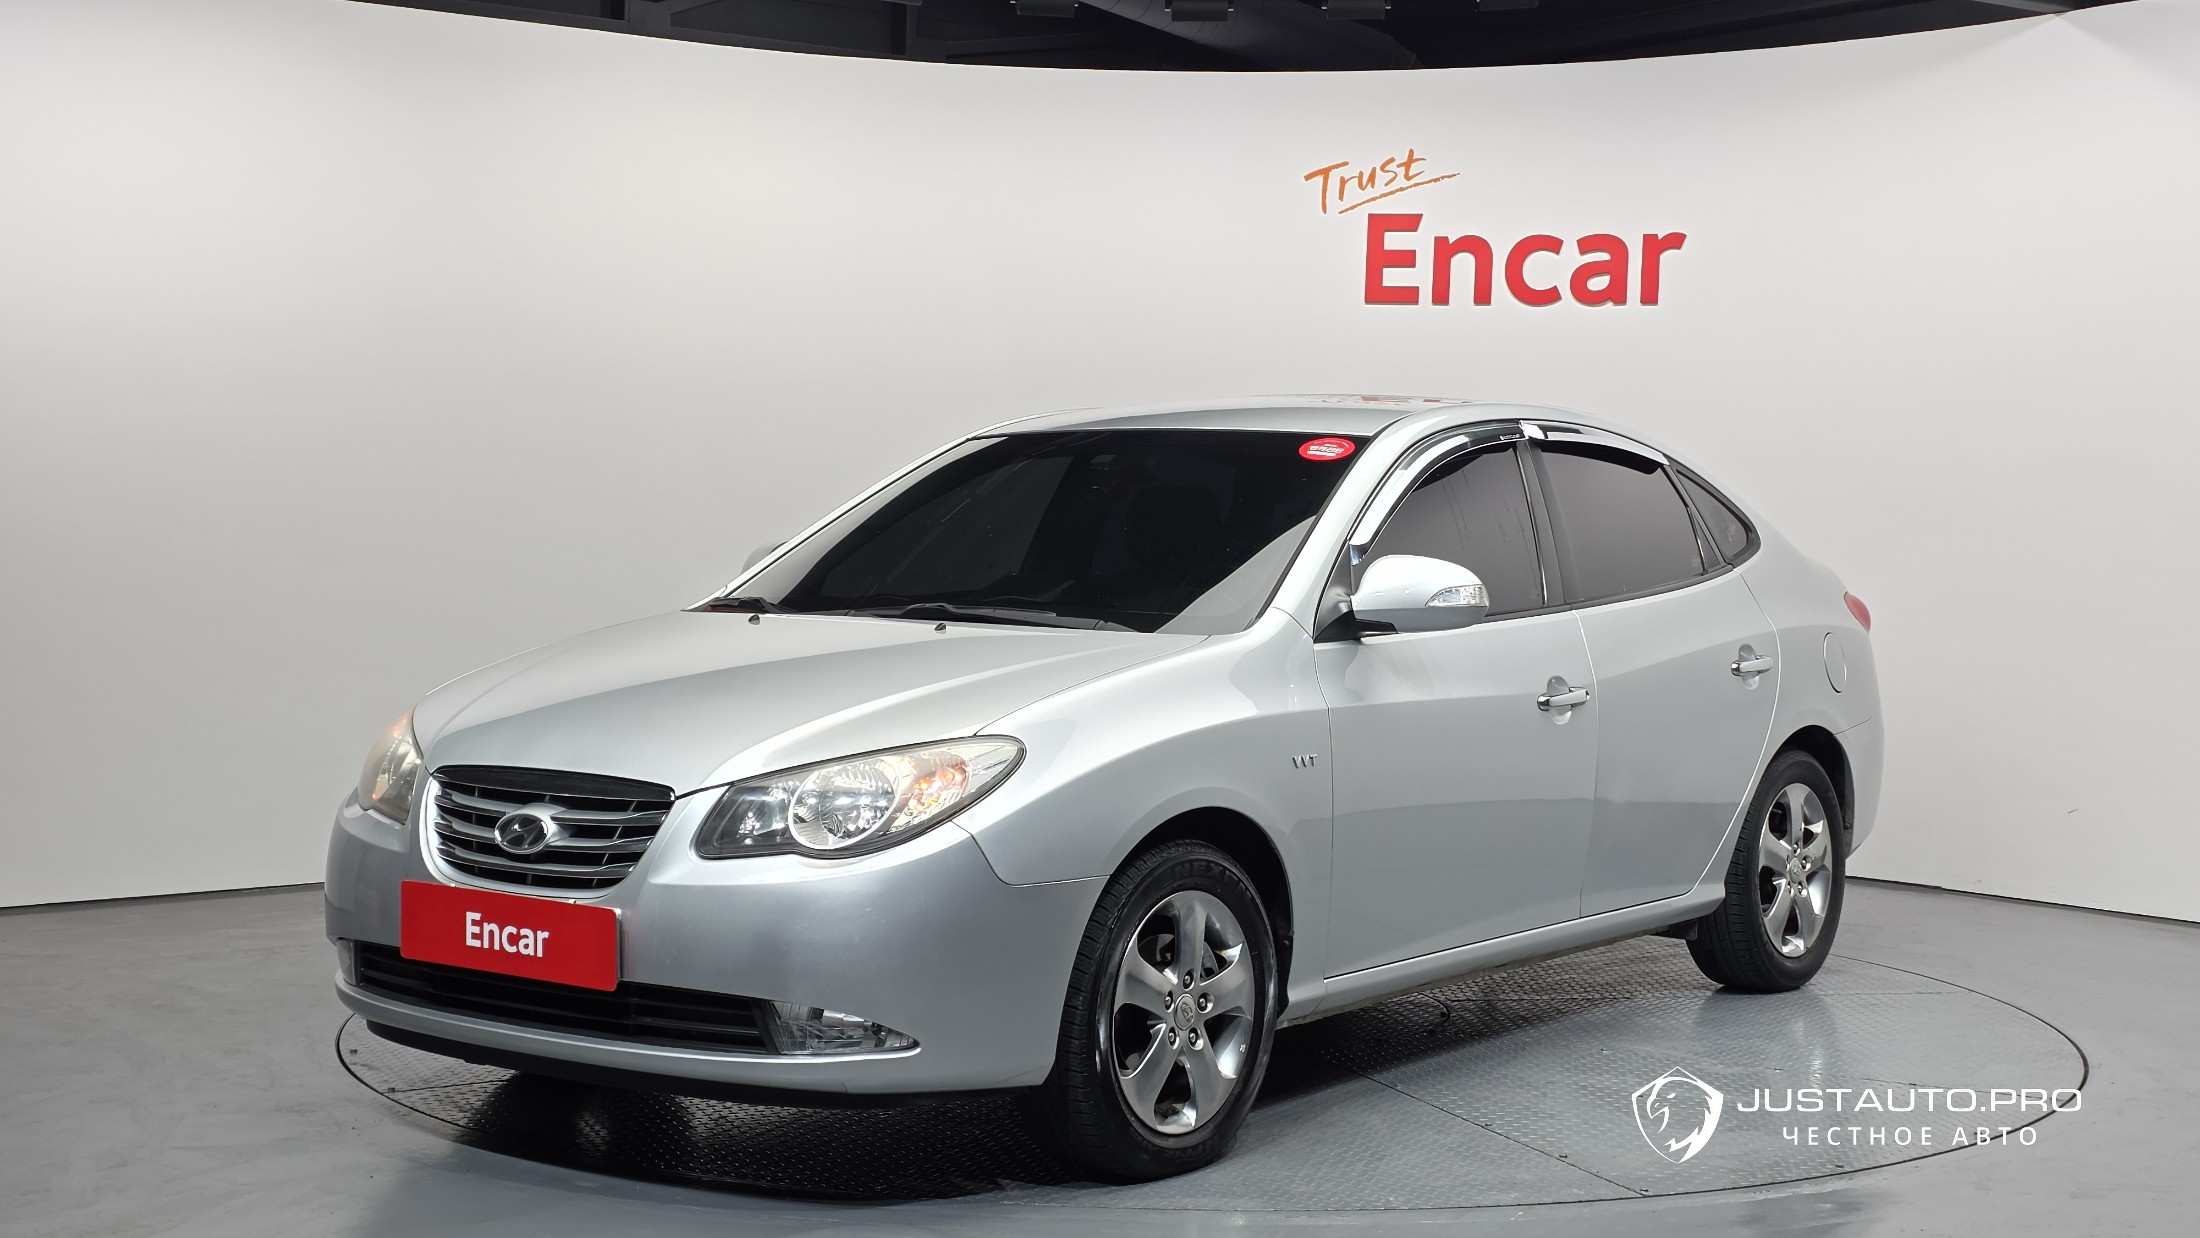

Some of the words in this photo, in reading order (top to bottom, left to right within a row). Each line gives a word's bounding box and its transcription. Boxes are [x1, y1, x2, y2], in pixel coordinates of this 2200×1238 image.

[1304, 148, 1428, 215] Trust
[1364, 212, 1687, 307] Encar
[1292, 753, 1318, 769] VVT
[465, 911, 550, 958] Encar
